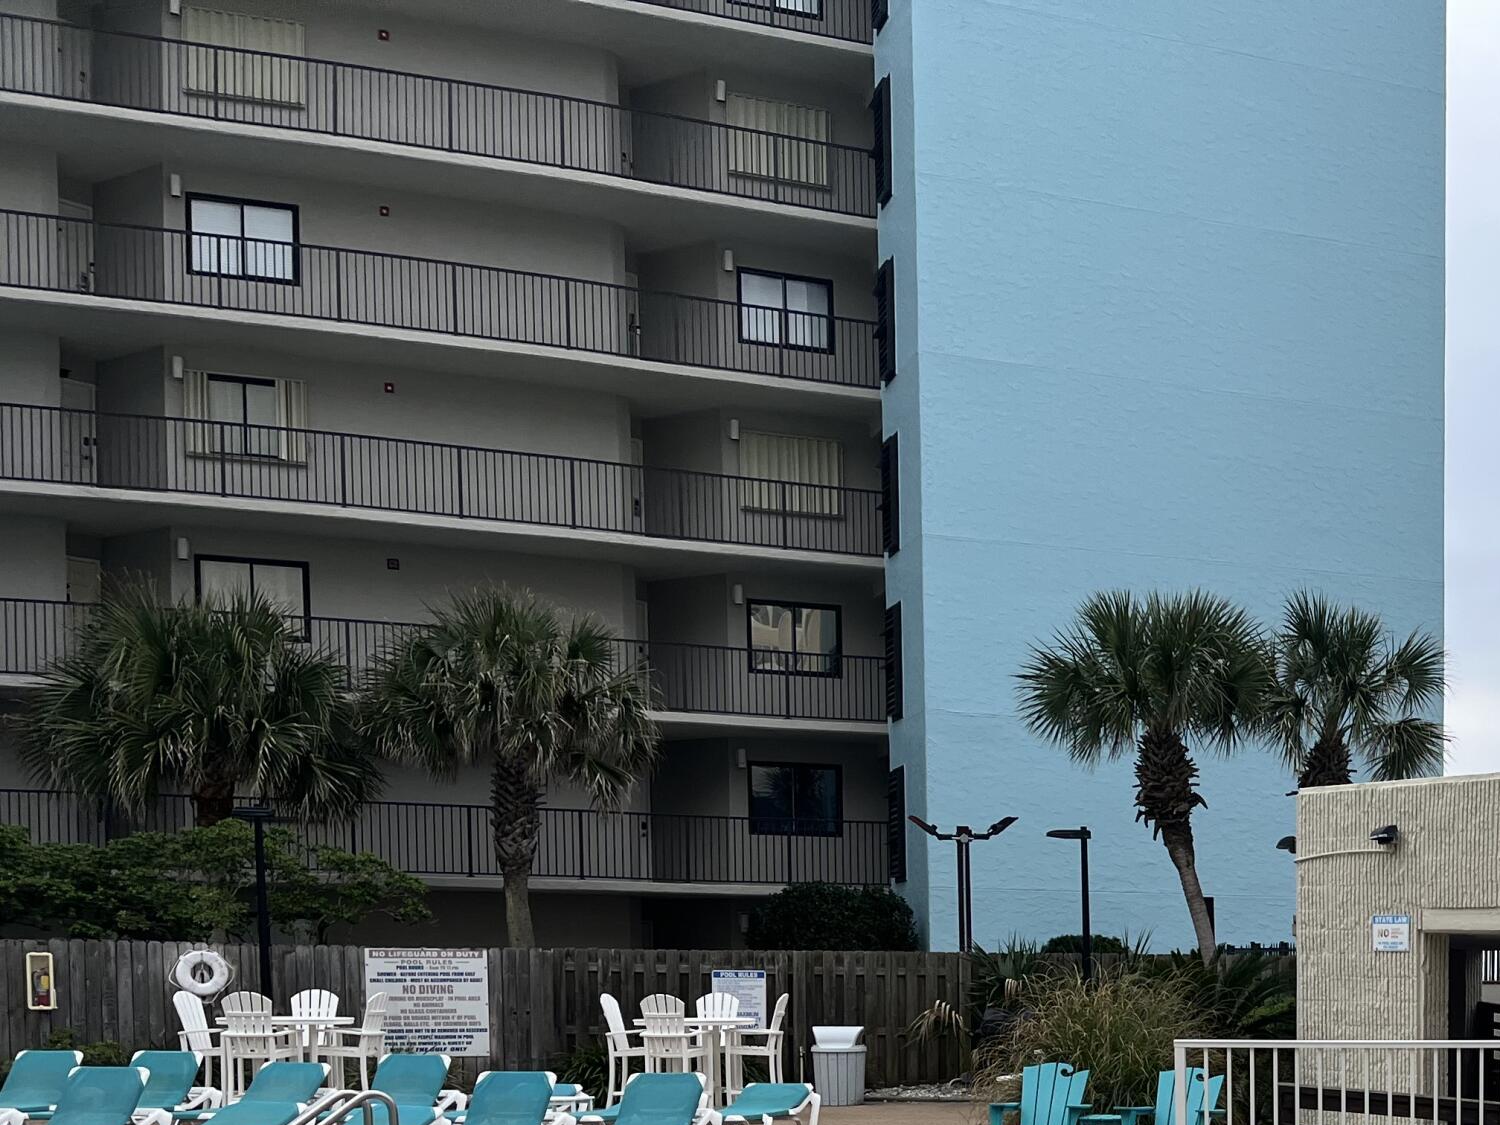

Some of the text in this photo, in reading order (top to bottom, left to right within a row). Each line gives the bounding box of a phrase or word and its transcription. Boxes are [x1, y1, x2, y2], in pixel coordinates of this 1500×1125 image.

[1374, 916, 1408, 924] STATE LAW
[1378, 929, 1390, 938] NO
[402, 985, 454, 994] NO DIVING
